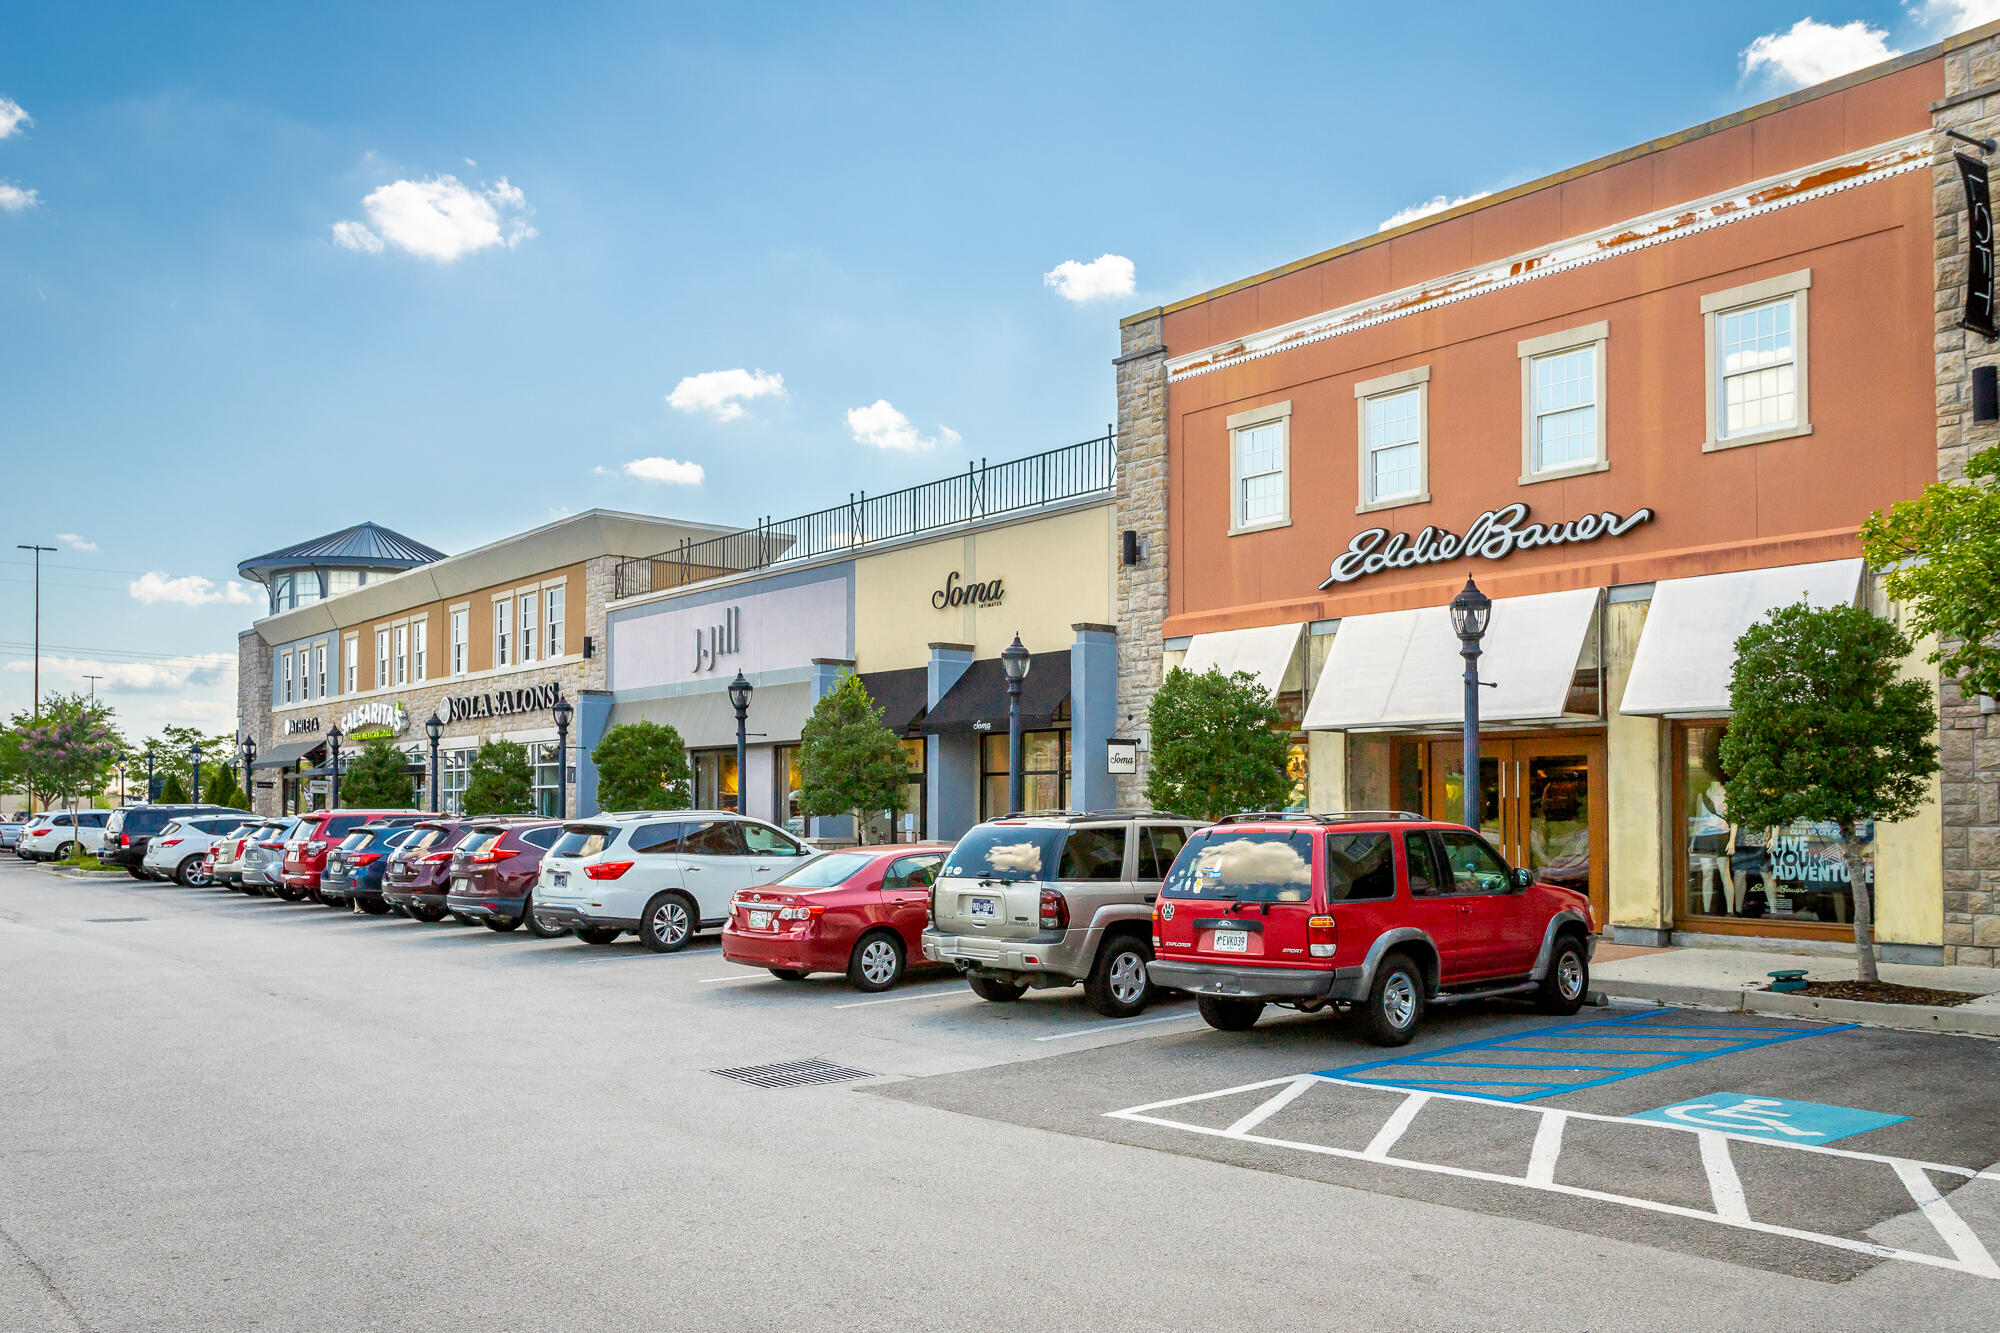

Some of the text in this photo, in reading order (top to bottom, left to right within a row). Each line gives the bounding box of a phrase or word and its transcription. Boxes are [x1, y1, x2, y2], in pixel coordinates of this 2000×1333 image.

[1968, 174, 1992, 316] LOFT
[1317, 502, 1655, 591] Eddie Bauer
[932, 571, 1004, 609] Soma
[451, 682, 560, 720] SOLA SALONS
[289, 717, 320, 733] ATHLETA
[973, 719, 991, 730] Soma
[1110, 752, 1134, 764] Soma
[1774, 836, 1808, 852] LIVE
[1771, 850, 1823, 868] YOUR
[1772, 864, 1874, 883] ADVENTUE
